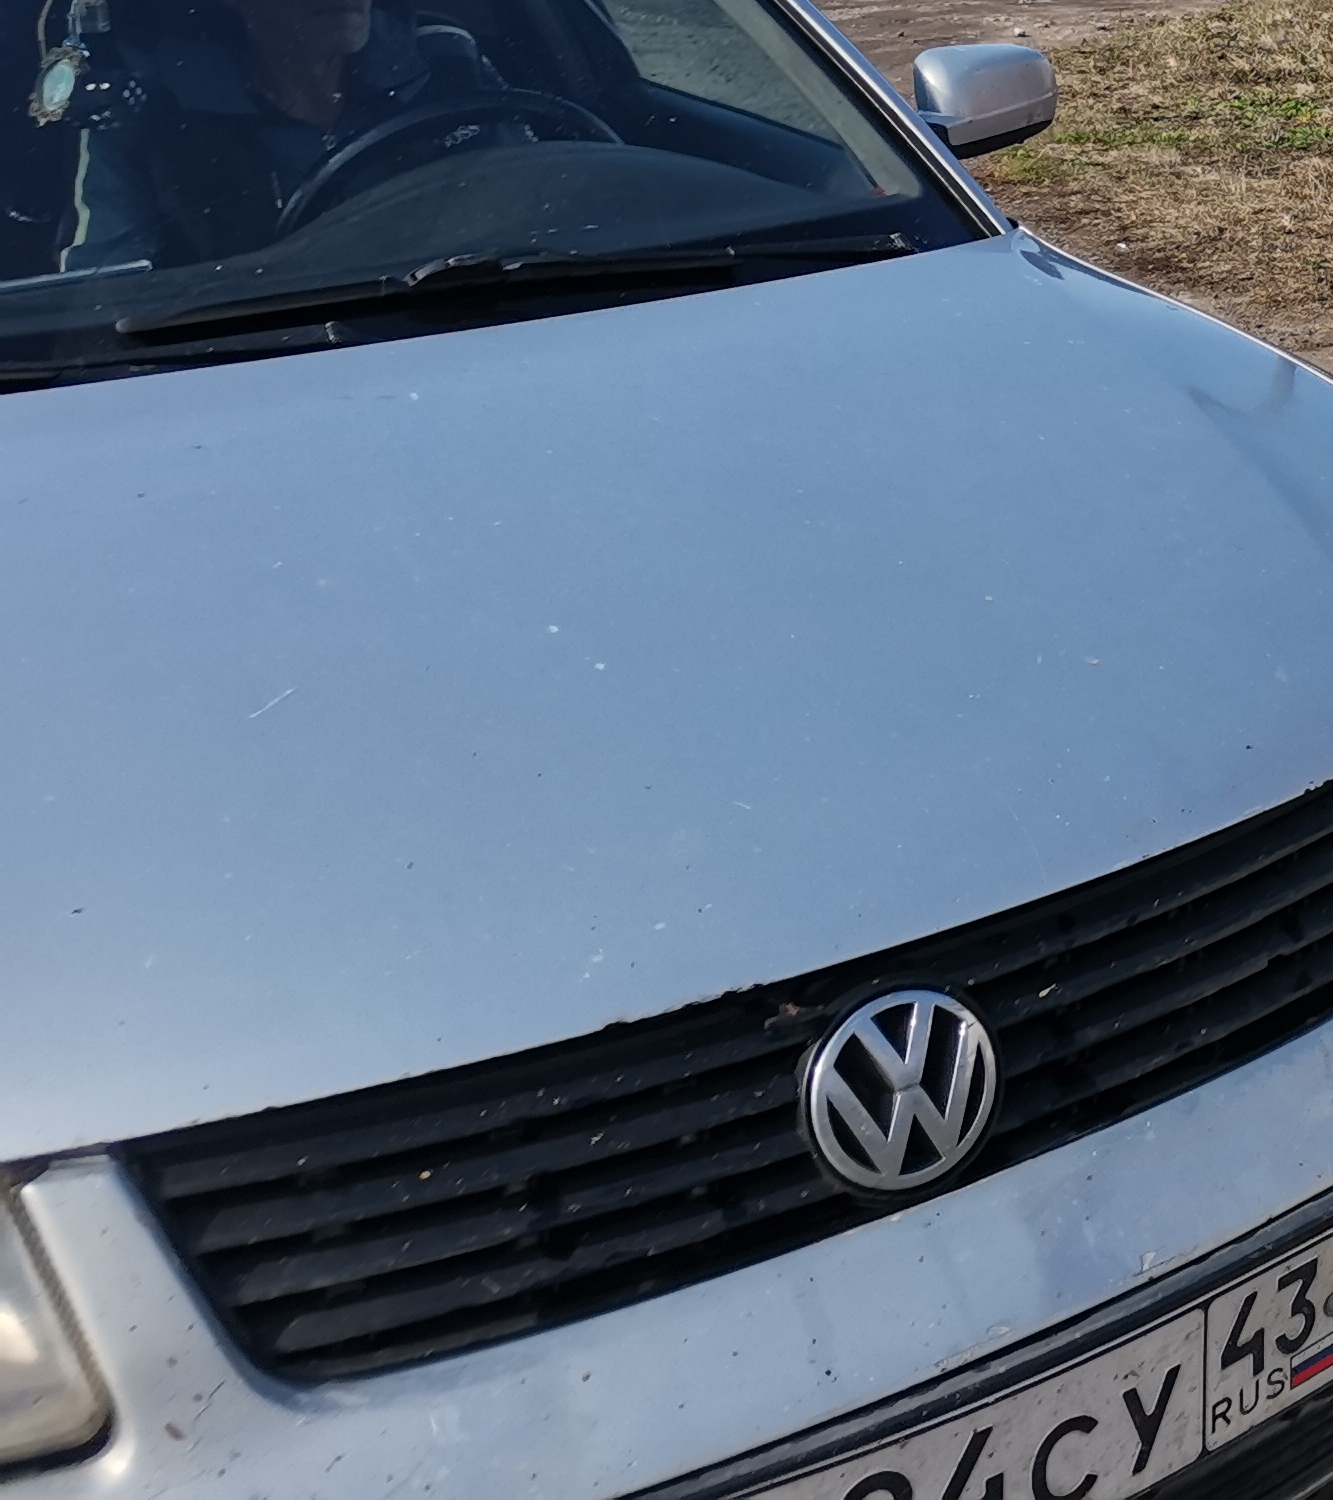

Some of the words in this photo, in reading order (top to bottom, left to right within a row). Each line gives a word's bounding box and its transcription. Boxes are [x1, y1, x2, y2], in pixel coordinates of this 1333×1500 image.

[1219, 1257, 1319, 1378] 43
[843, 1364, 1182, 1500] 4СУ
[1210, 1366, 1286, 1436] RUS
